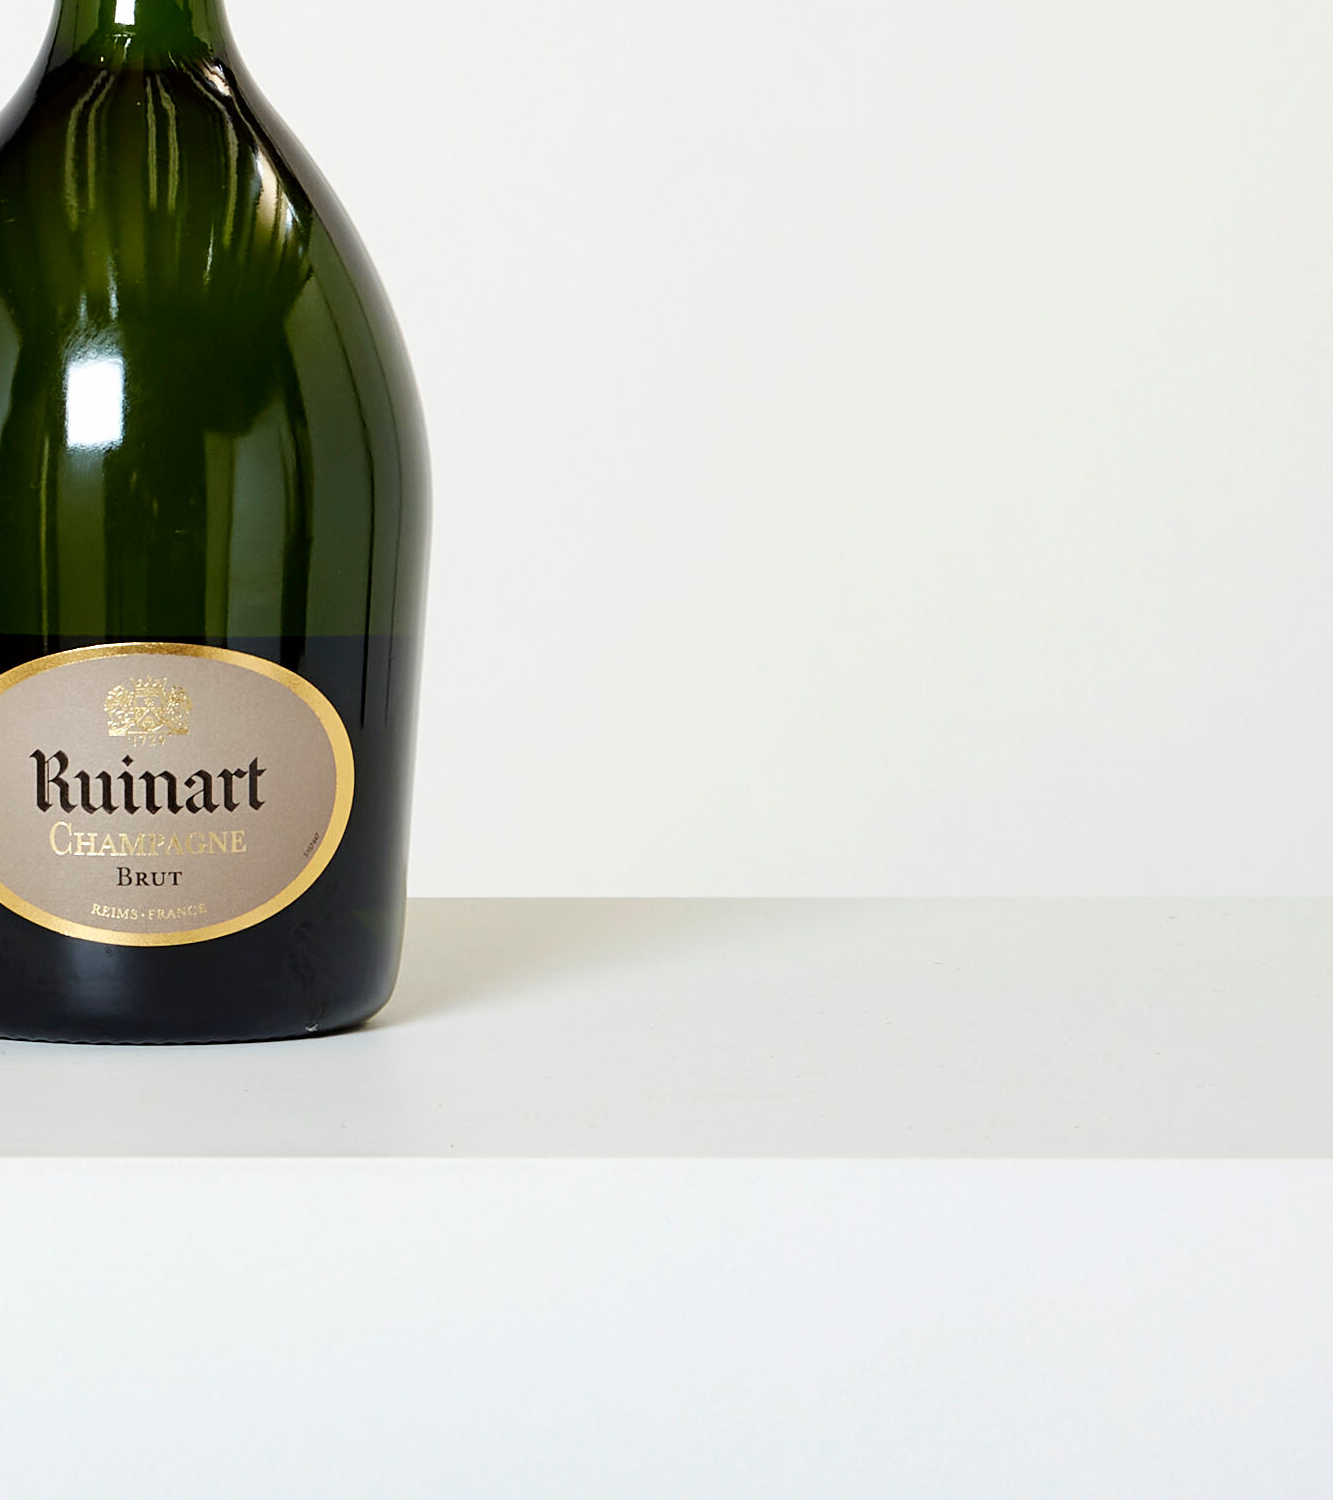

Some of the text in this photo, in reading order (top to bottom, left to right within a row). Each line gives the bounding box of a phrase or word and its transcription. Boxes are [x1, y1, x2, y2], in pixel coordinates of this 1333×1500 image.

[30, 749, 267, 815] Ruinart
[48, 821, 247, 857] CHAMPAGNE
[117, 867, 183, 887] BRUT
